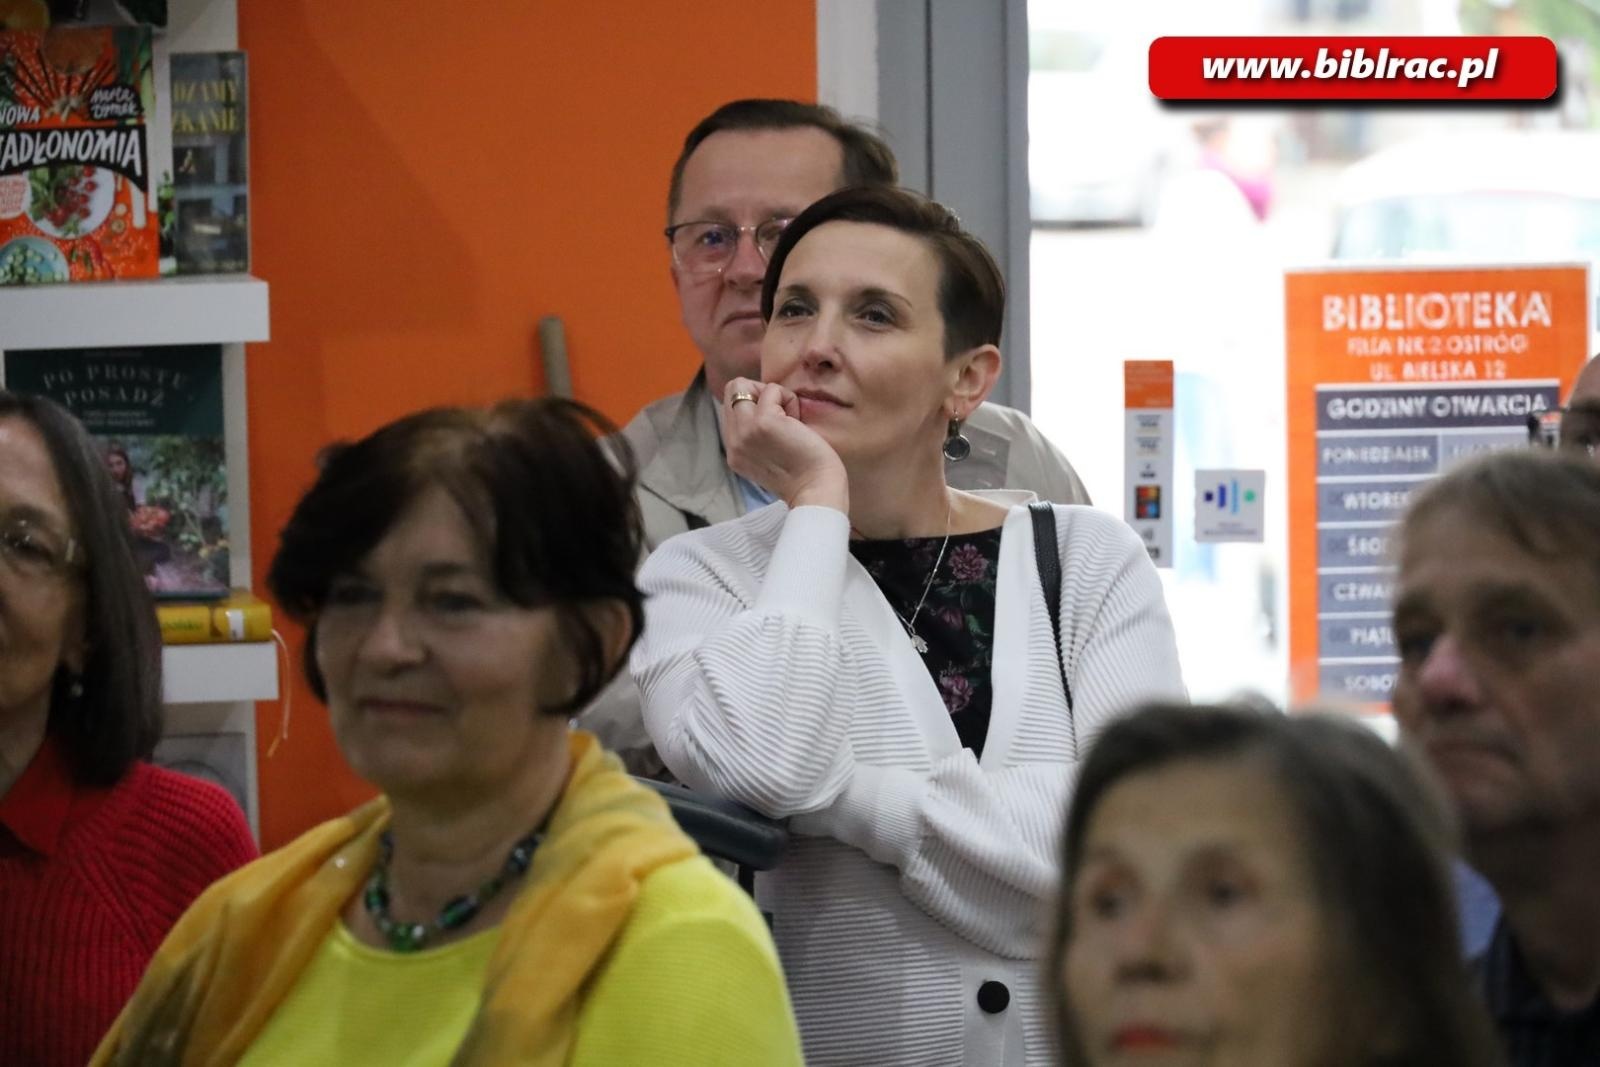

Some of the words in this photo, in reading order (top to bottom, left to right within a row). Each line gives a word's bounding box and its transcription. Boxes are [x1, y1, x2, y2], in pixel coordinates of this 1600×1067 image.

[1322, 291, 1552, 331] BIBLIOTEKA
[1326, 398, 1427, 420] GODZINY
[1431, 393, 1549, 418] OTWARCIA
